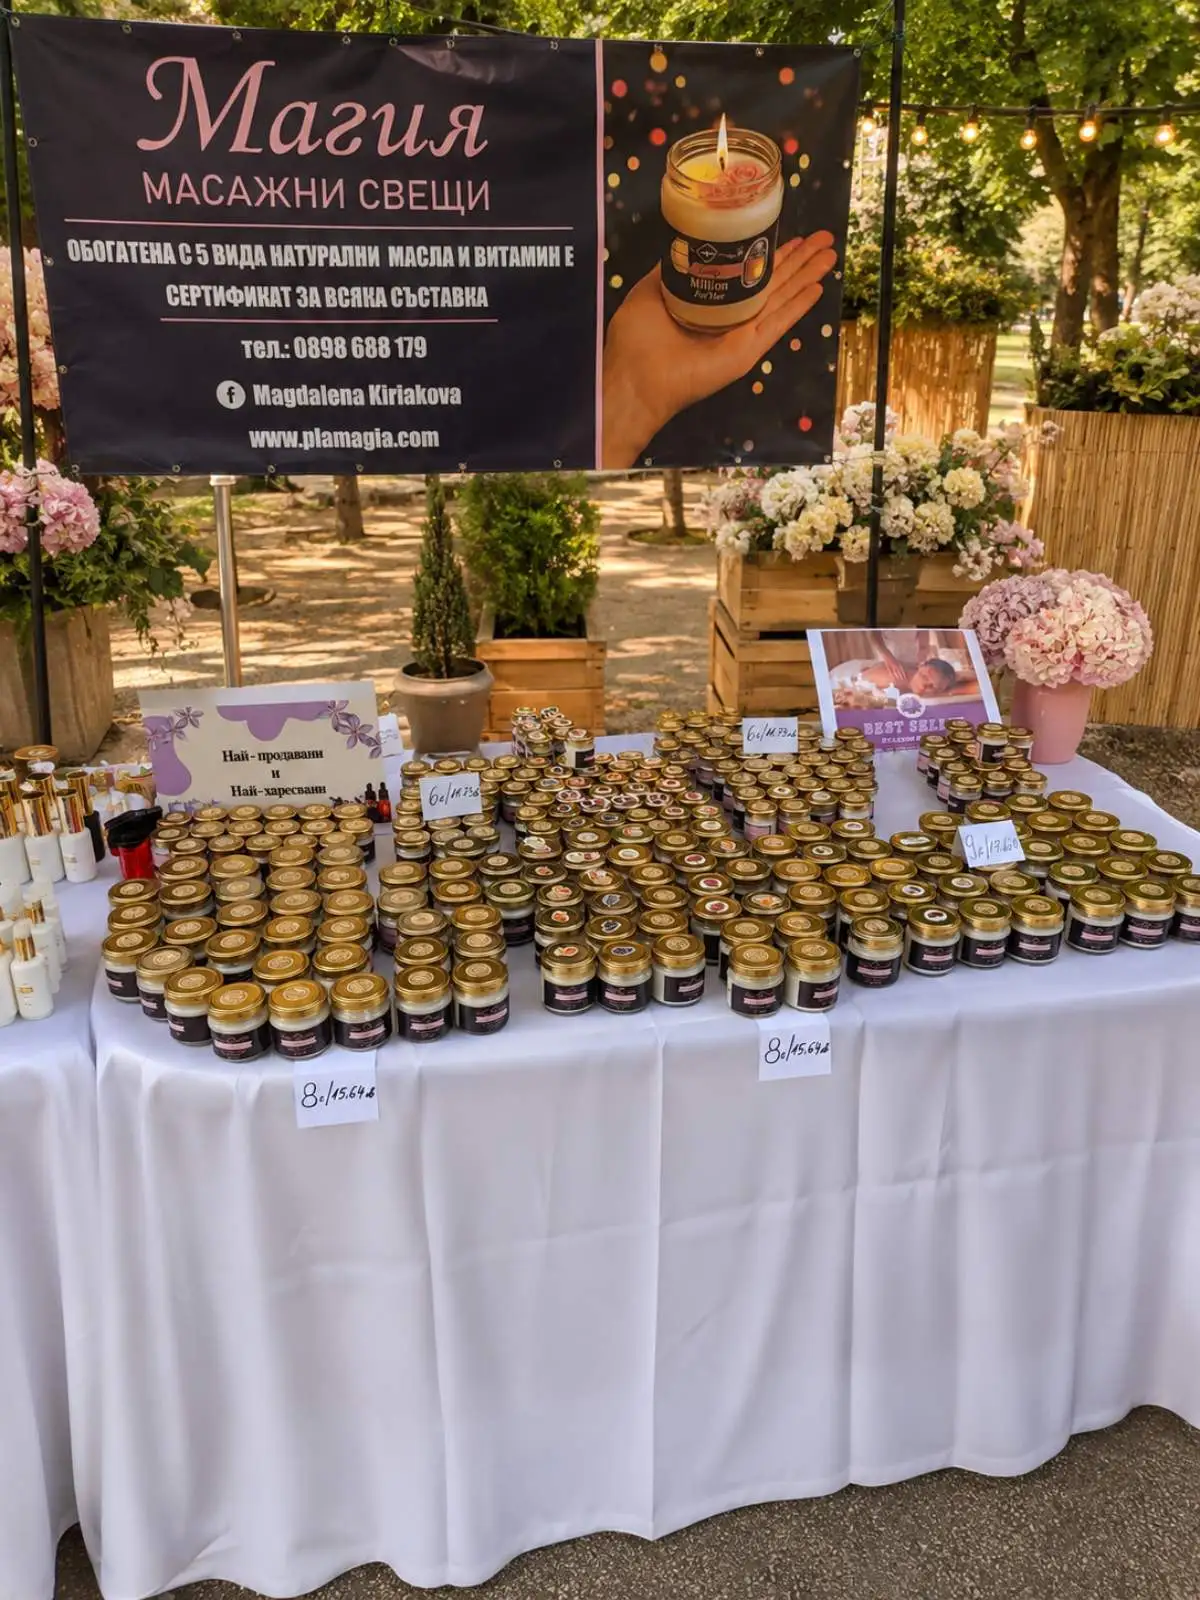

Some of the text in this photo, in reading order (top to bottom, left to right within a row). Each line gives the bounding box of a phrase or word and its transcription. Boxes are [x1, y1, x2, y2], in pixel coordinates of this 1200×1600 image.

[136, 56, 489, 158] Магия
[142, 171, 490, 216] МАСАЖНИ СВЕЩИ
[66, 238, 176, 265] ОБОГАТЕНА
[178, 242, 192, 265] С
[195, 243, 210, 266] 5
[211, 243, 267, 270] ВИДА
[269, 244, 380, 267] НАТУРАЛНИ
[388, 245, 456, 268] МАСЛА
[457, 246, 471, 268] И
[474, 246, 561, 268] ВИТАМИН
[165, 284, 489, 308] СЕРТИФИКАТ ЗА ВСЯКА СЪСТАВКА
[241, 336, 428, 360] тел.: 0898 688 179
[252, 384, 365, 409] Magdalena
[368, 384, 463, 406] Kiriakova
[249, 428, 440, 451] www.plamagia.com
[863, 720, 905, 736] BEST
[271, 769, 280, 779] и
